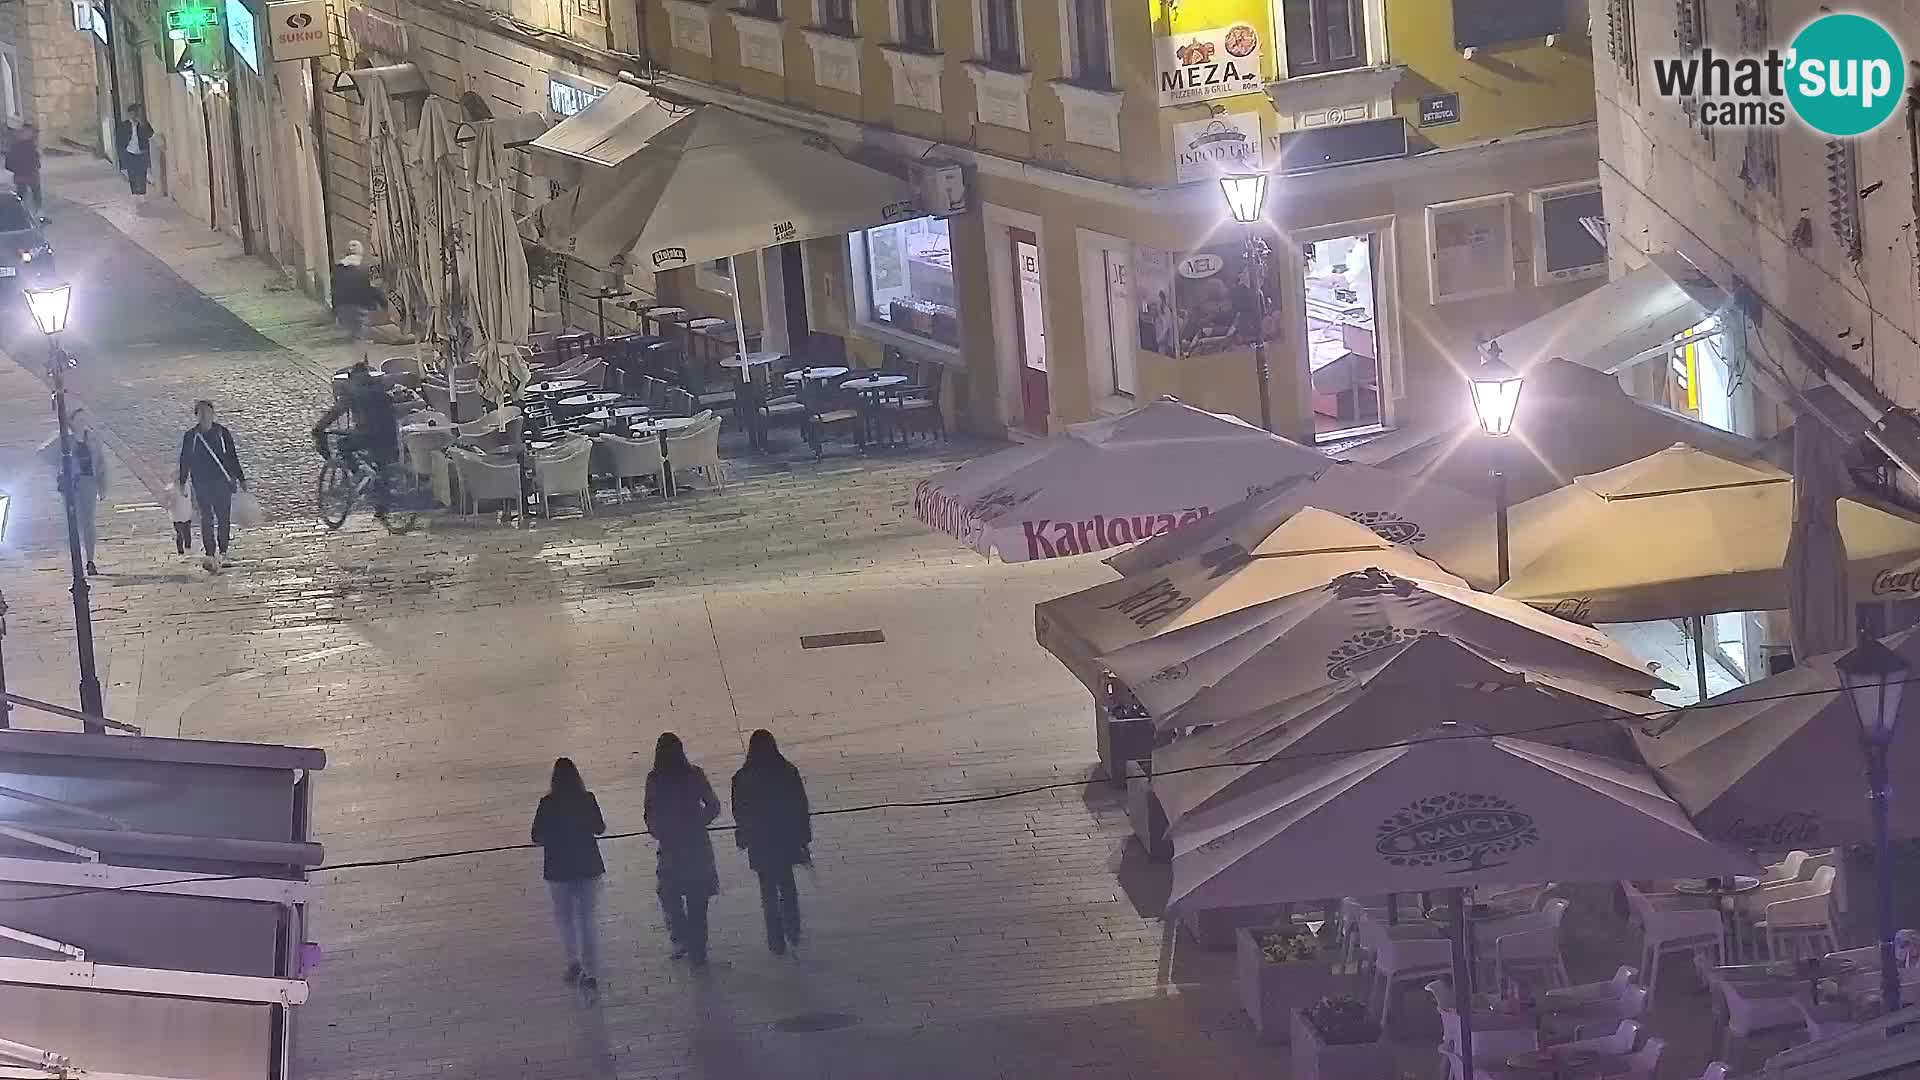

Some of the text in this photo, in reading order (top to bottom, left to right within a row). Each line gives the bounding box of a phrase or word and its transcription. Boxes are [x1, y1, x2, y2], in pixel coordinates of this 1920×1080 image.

[1162, 61, 1240, 91] MEZA
[1170, 88, 1202, 100] PIZZERIA
[1211, 84, 1232, 94] GRILL
[1180, 147, 1225, 165] ISPOD
[1416, 815, 1515, 846] RAUCH
